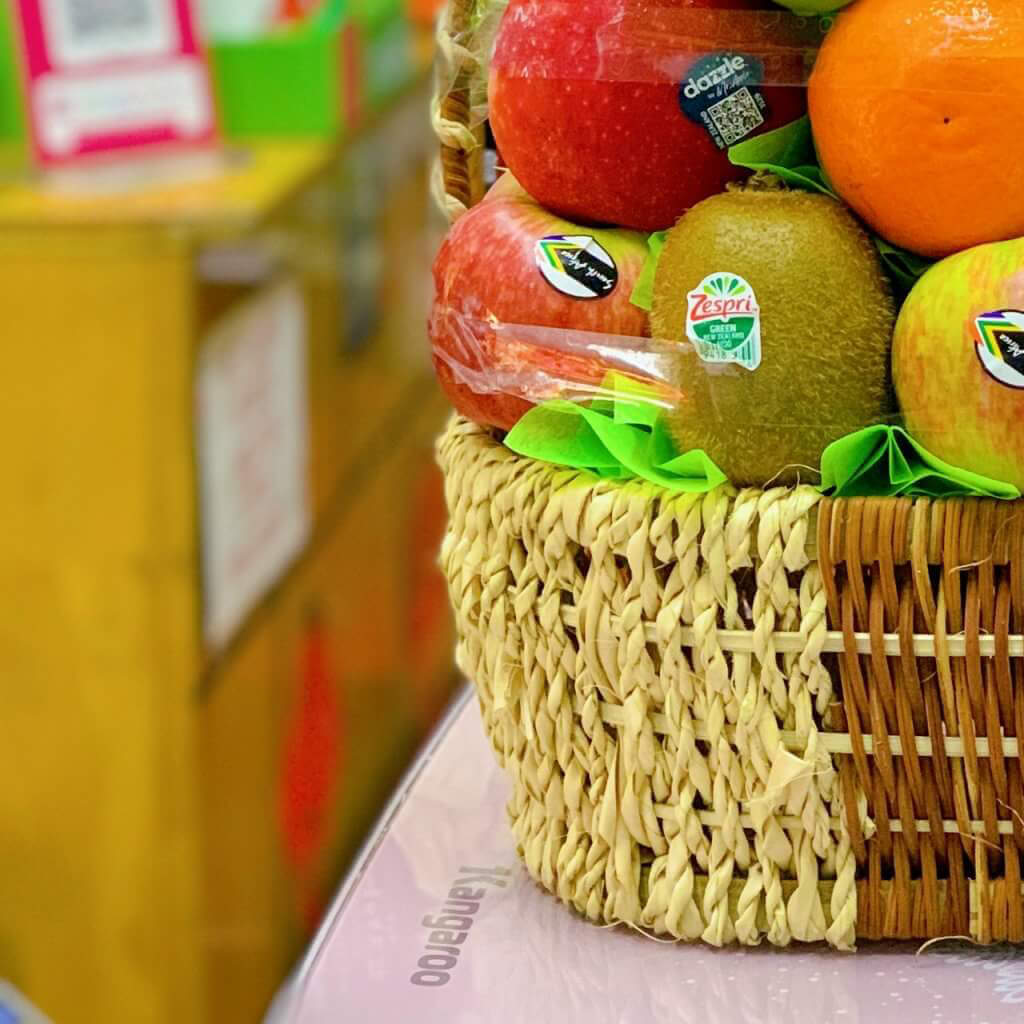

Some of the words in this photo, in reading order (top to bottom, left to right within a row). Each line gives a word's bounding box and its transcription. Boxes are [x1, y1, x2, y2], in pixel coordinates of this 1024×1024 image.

[684, 56, 745, 98] dazzle
[690, 294, 754, 322] Zespri
[410, 865, 512, 987] Kangaroo
